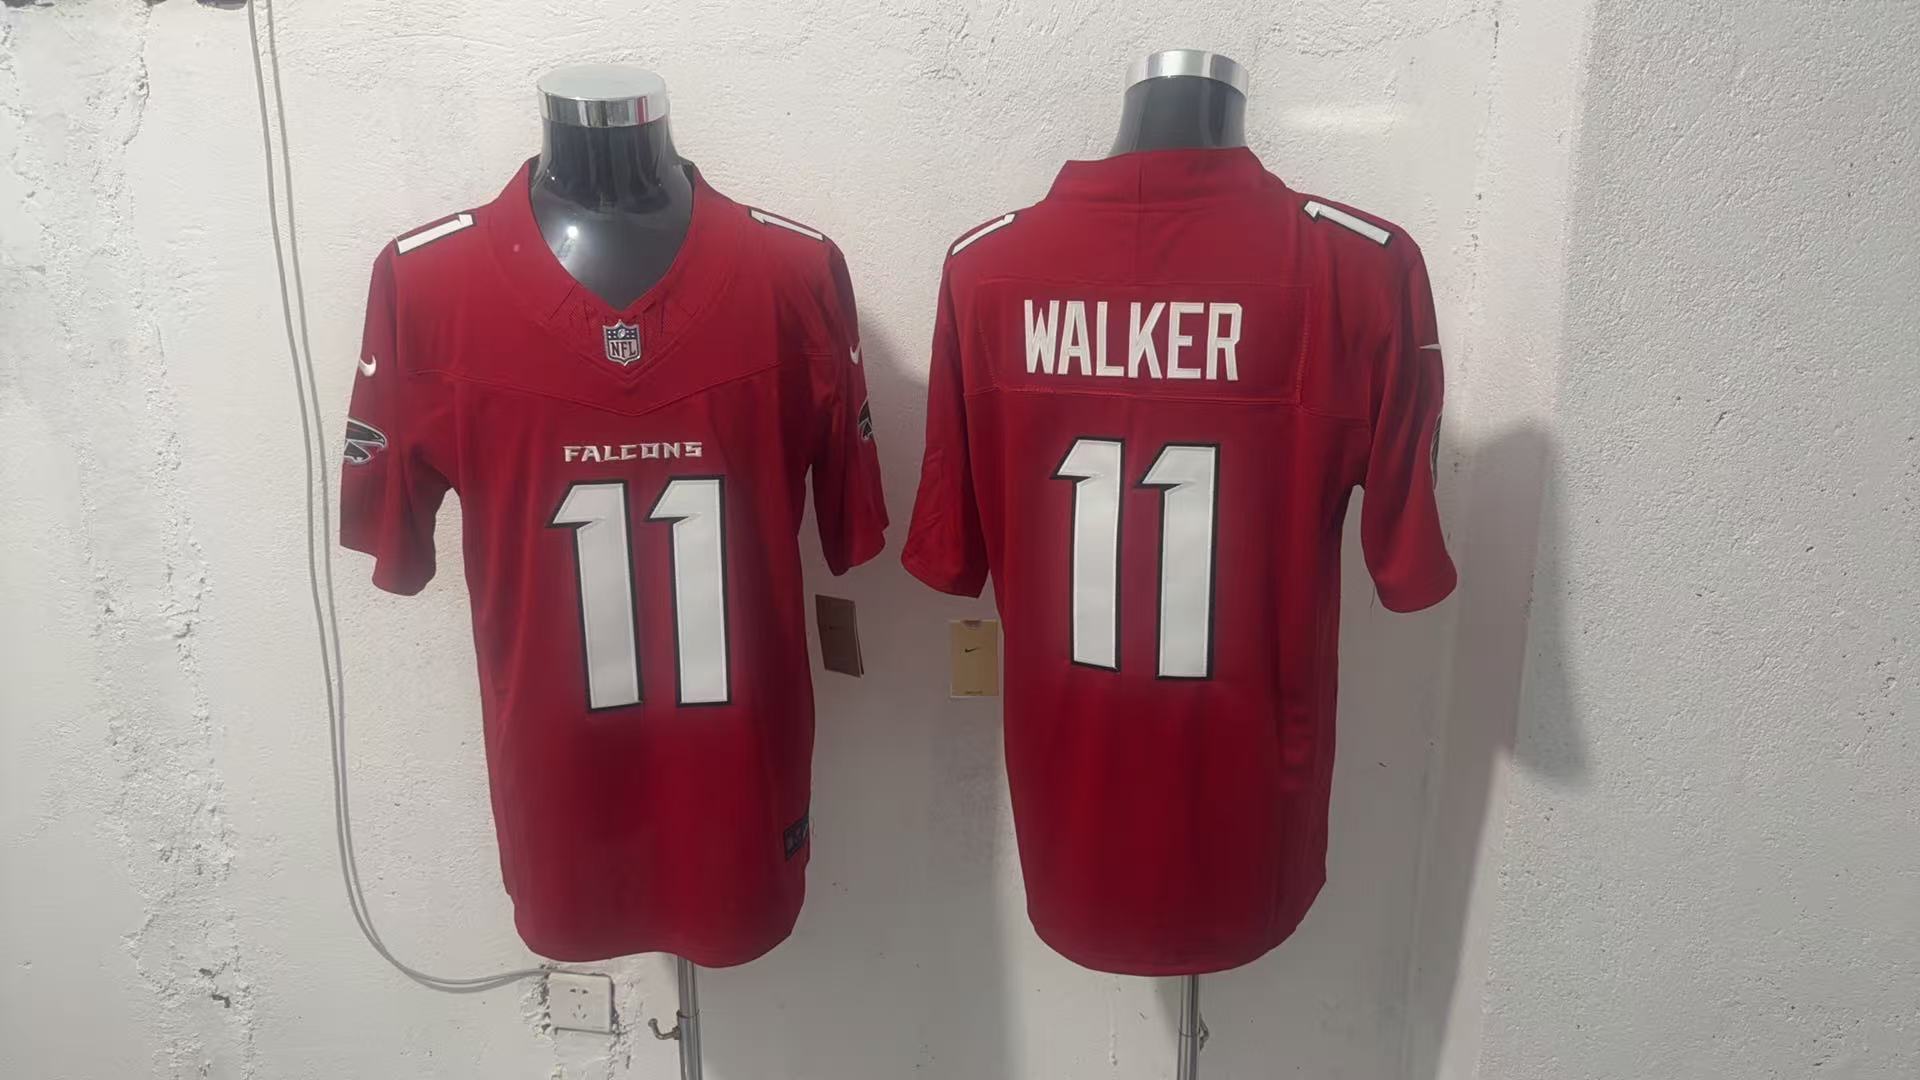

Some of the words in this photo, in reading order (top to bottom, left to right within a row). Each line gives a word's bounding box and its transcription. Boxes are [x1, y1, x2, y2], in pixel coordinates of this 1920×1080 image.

[610, 340, 637, 358] NFL
[1024, 299, 1243, 381] WALKER
[563, 441, 703, 463] FALCONS
[546, 476, 731, 711] 11
[1050, 437, 1220, 682] 11
